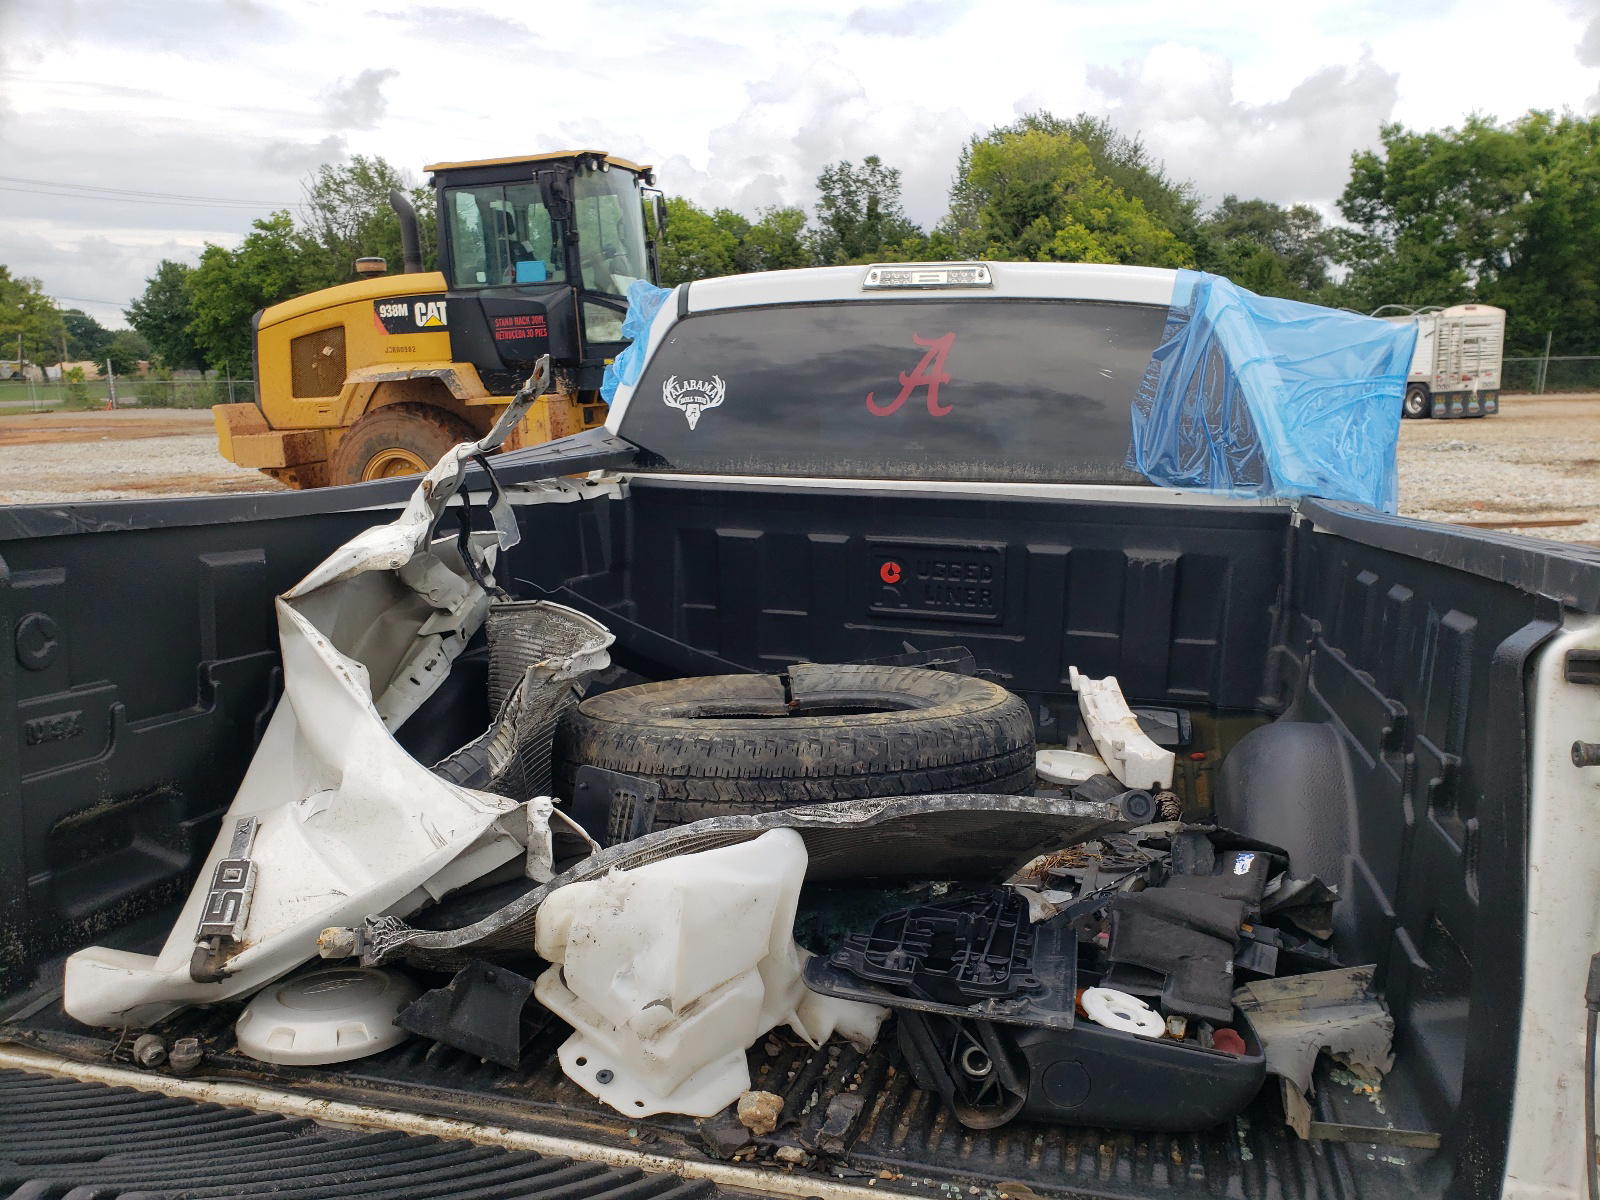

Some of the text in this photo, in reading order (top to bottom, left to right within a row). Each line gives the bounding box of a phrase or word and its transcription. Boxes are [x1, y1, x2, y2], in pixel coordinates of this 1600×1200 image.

[379, 303, 409, 318] 938M
[414, 301, 448, 327] CAT
[865, 331, 956, 417] A
[670, 379, 719, 399] ALABAMA
